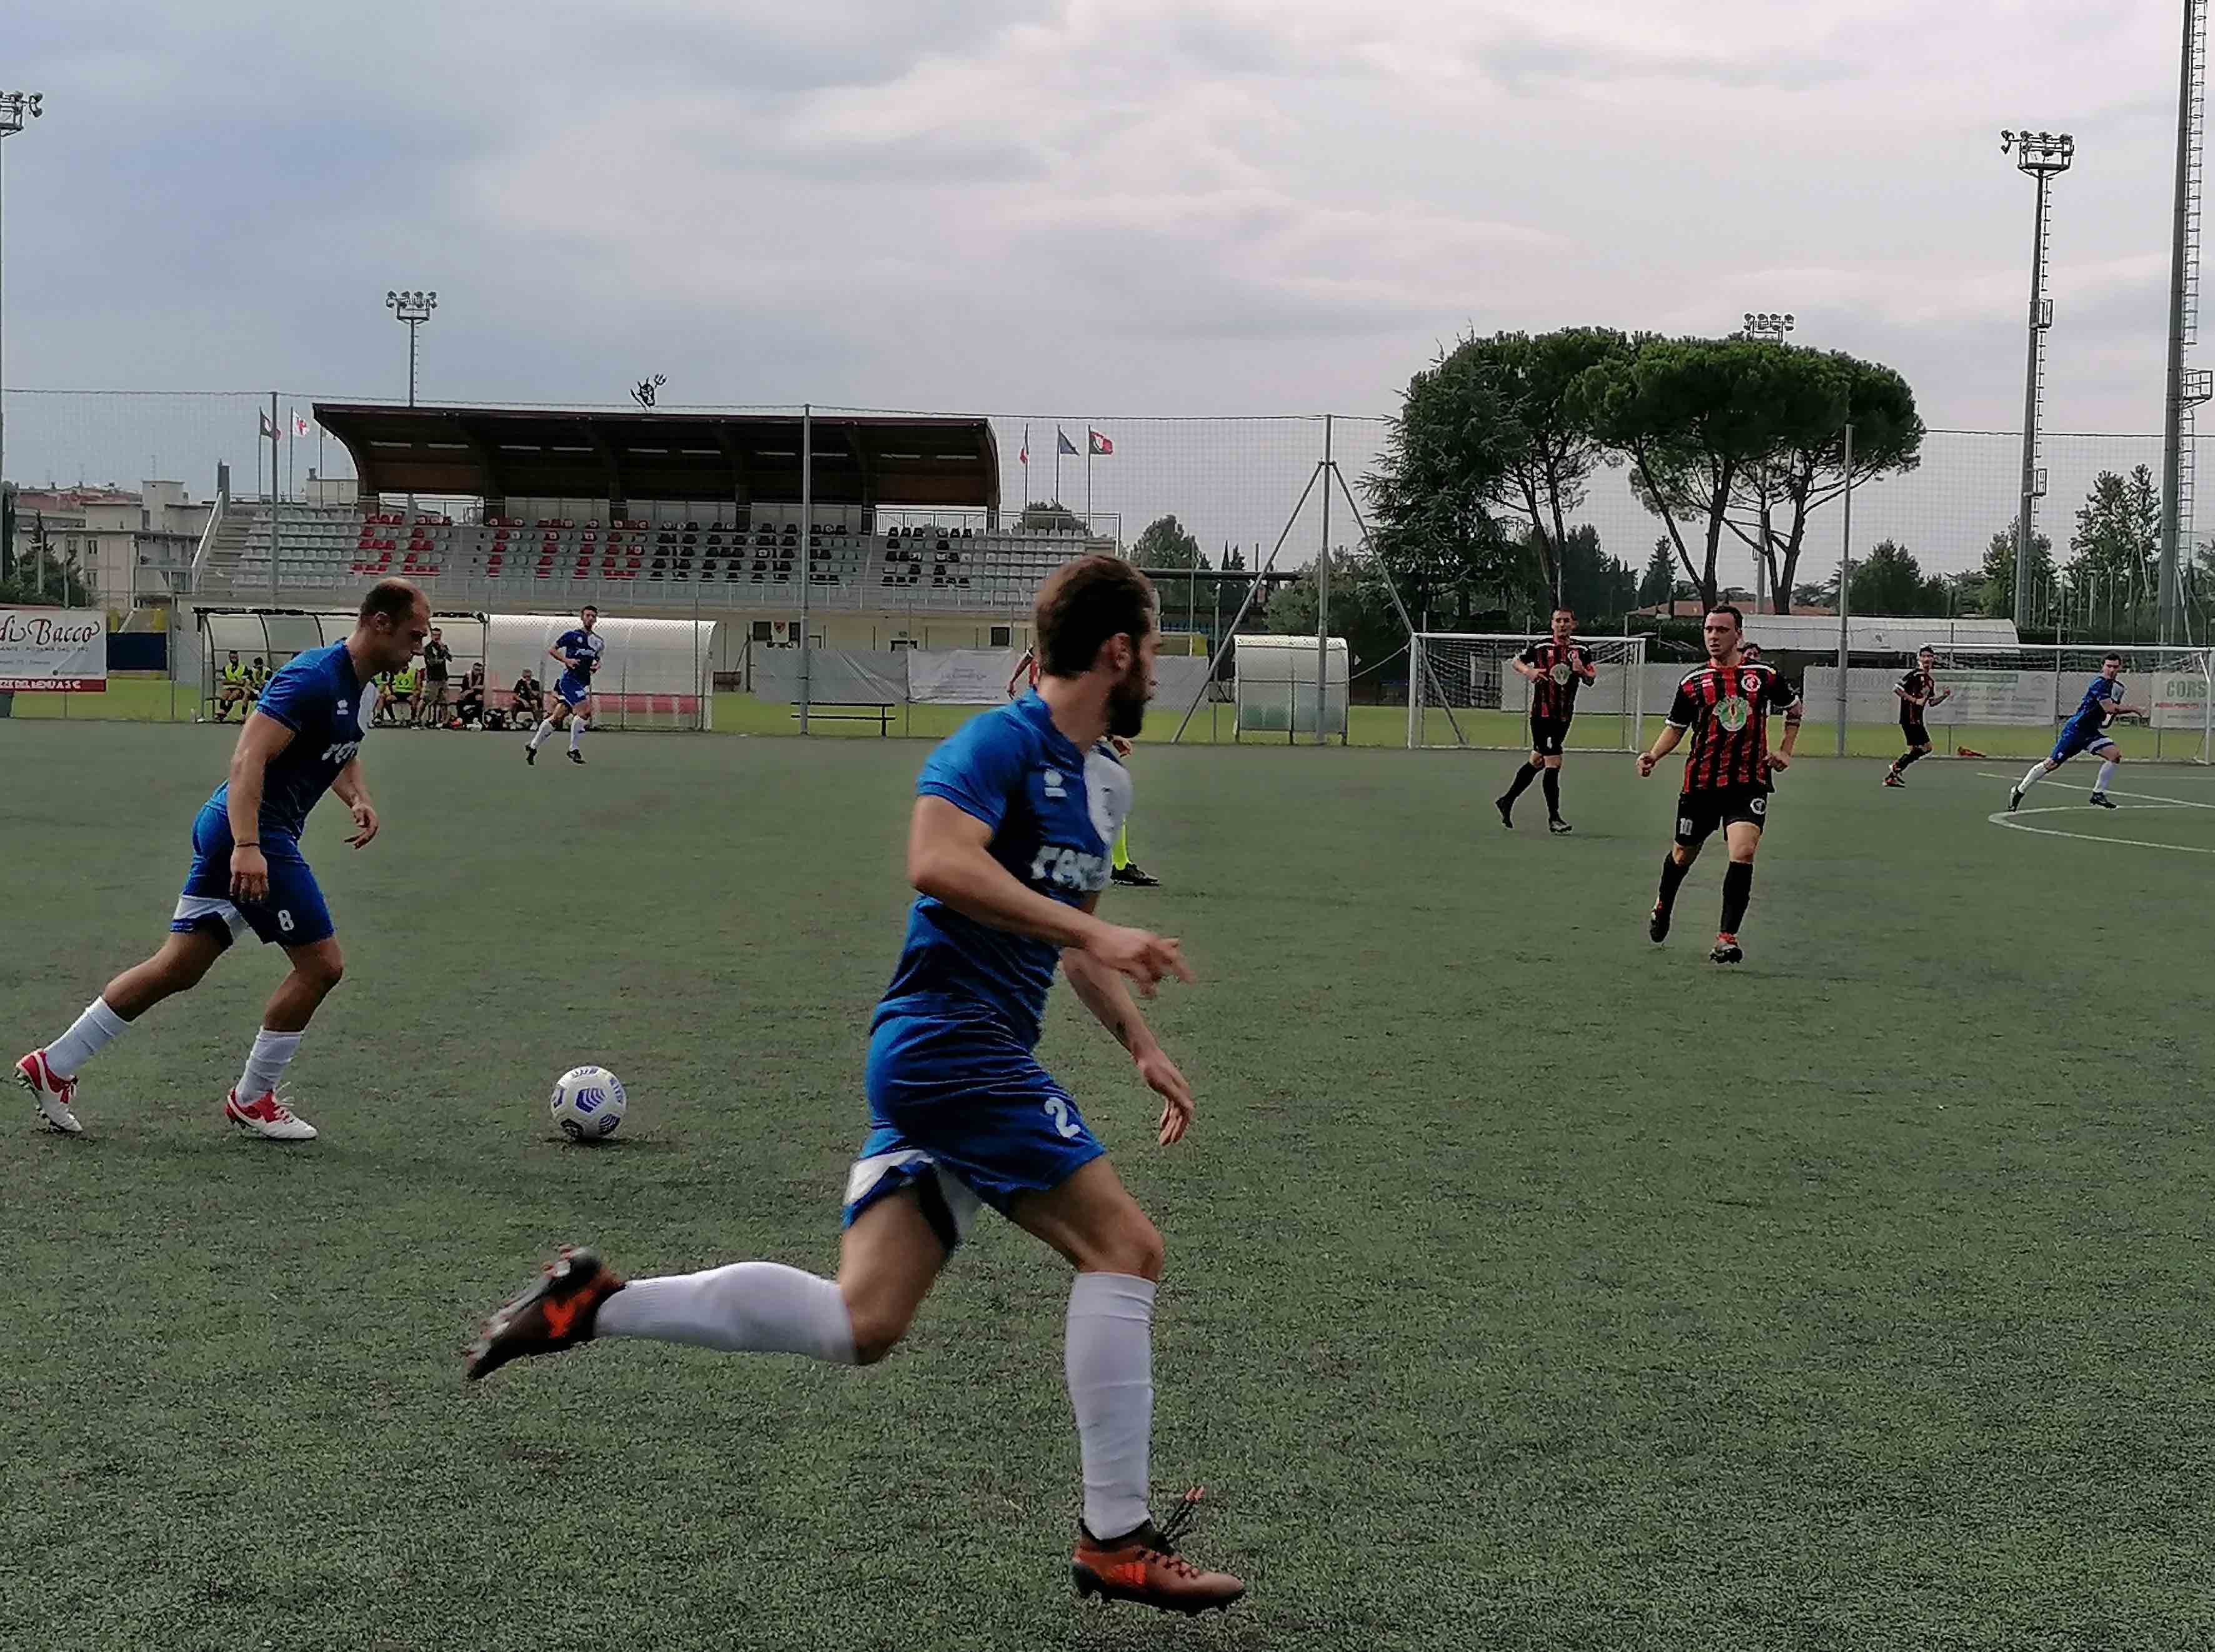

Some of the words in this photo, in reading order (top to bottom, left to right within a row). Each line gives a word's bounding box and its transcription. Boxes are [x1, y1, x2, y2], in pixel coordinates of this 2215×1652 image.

[27, 619, 100, 645] Bacco
[277, 910, 294, 931] 8
[1044, 1097, 1081, 1137] 2
